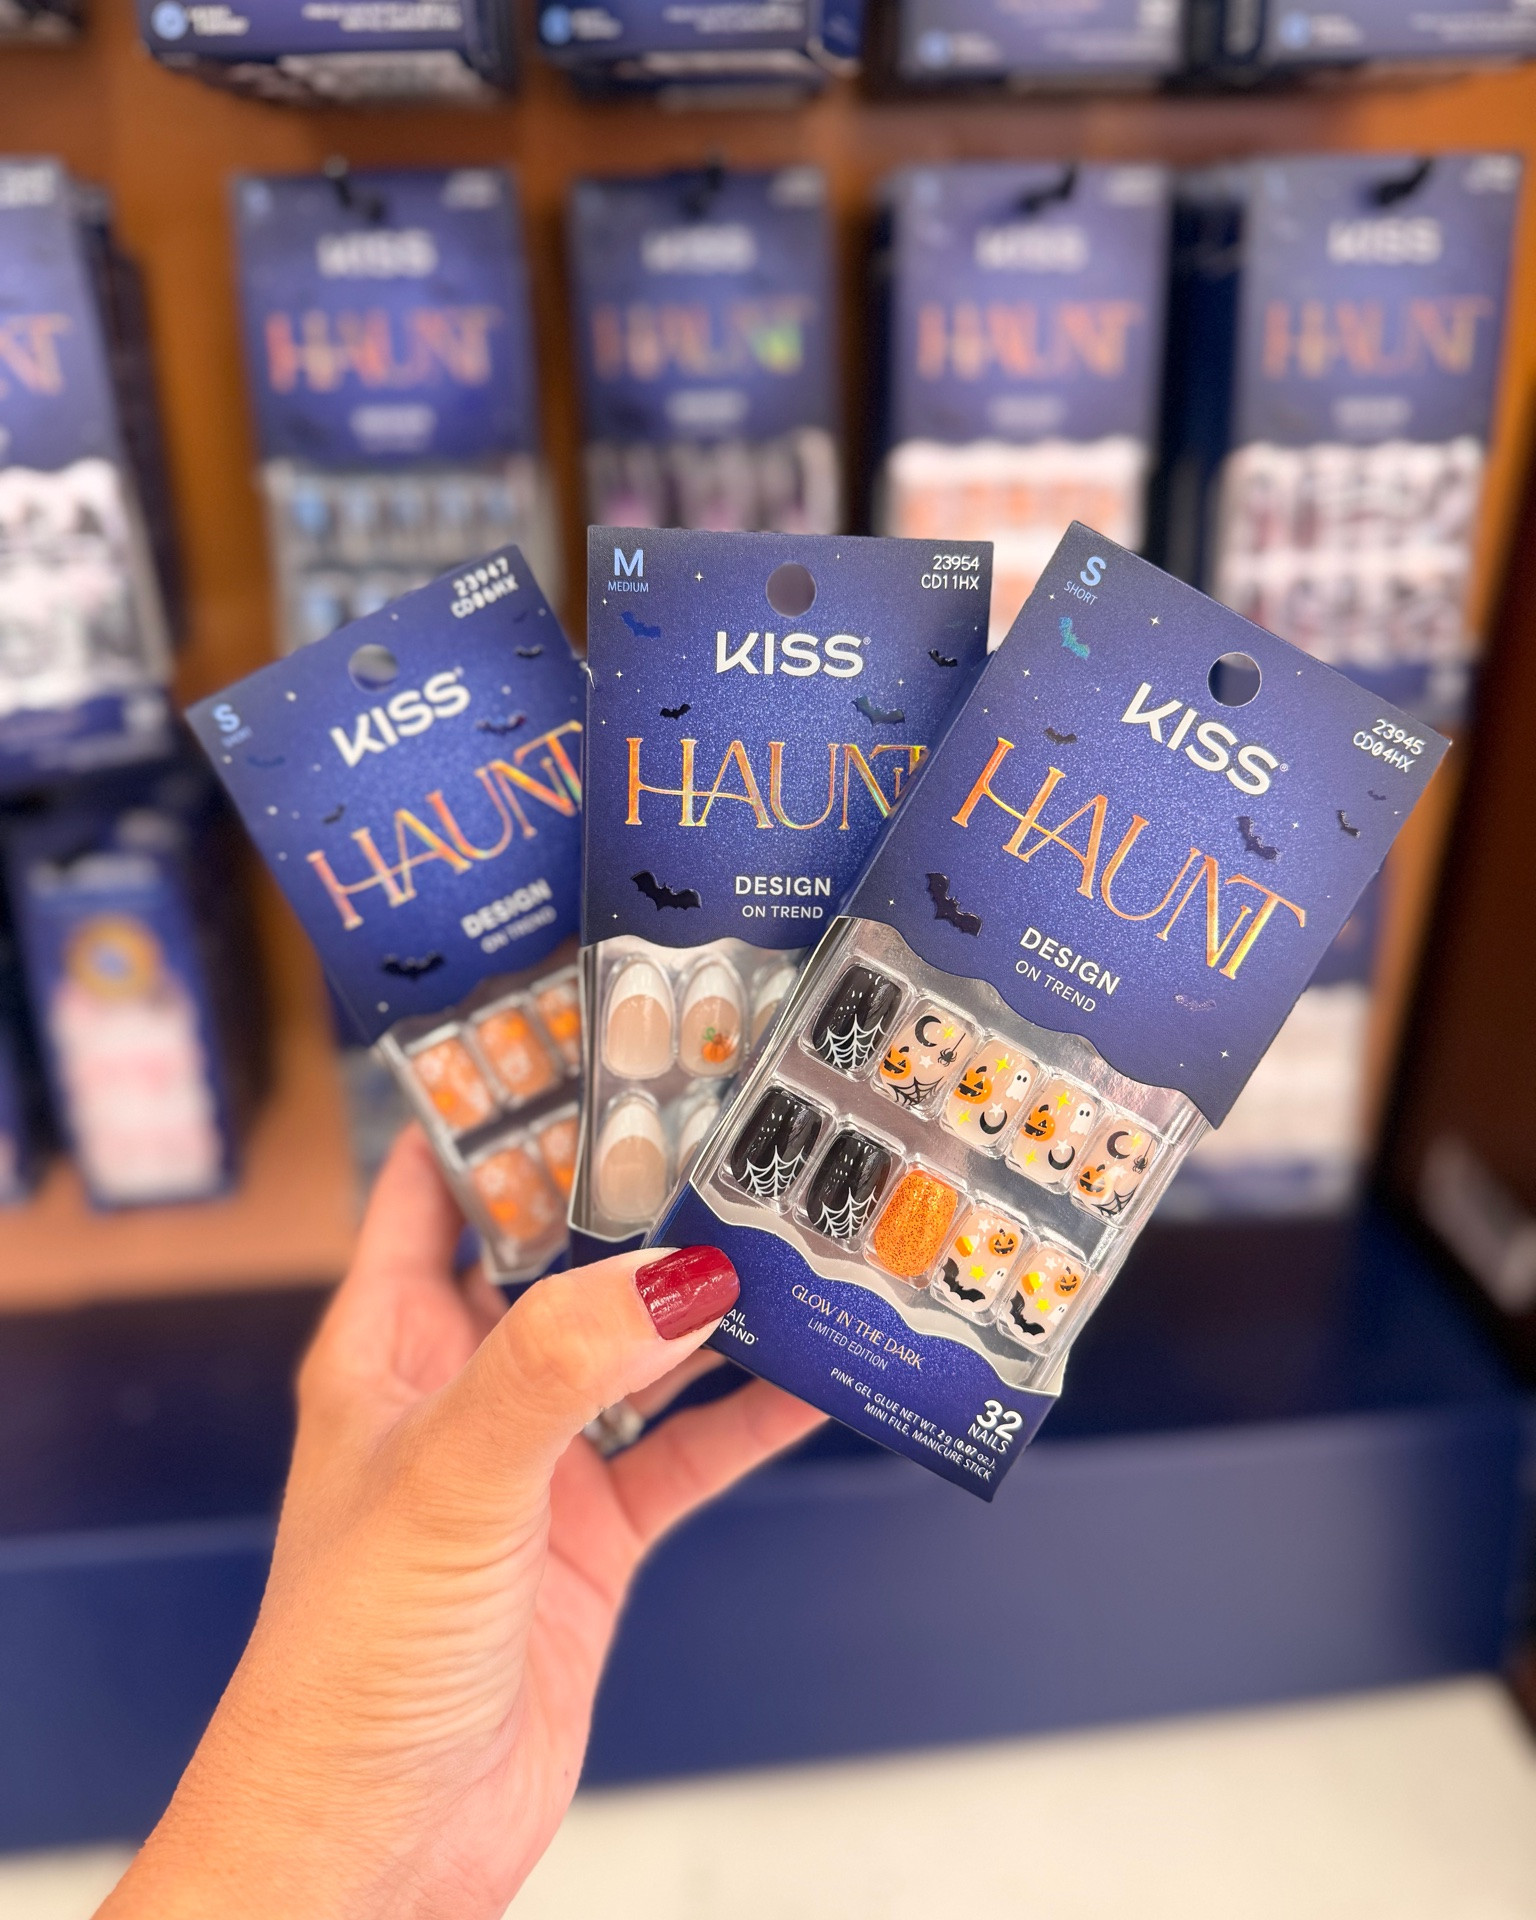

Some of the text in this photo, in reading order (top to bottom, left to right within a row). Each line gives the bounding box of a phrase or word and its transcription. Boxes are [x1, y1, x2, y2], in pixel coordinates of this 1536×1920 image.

[613, 547, 644, 577] M
[932, 555, 980, 571] 23954
[1080, 556, 1107, 587] S
[607, 580, 649, 593] MEDIUM
[921, 573, 980, 590] CD11HX
[1063, 580, 1098, 606] SHORT
[213, 703, 241, 732] S
[1353, 731, 1416, 773] CD04HX
[1371, 718, 1427, 756] 23945
[951, 737, 1306, 980] HAUNT
[735, 875, 831, 896] DESIGN
[461, 878, 553, 939] DESIGN
[742, 905, 824, 919] ON TREND
[1020, 926, 1121, 995] DESIGN
[1015, 960, 1096, 1012] ON TREND
[726, 1308, 746, 1327] AIL
[791, 1284, 926, 1370] GLOW IN THE DARK
[807, 1317, 889, 1371] LIMITED EDITION
[830, 1367, 854, 1388] PINK
[854, 1381, 873, 1399] GEL
[874, 1393, 900, 1413] GLUE
[899, 1407, 920, 1425] NET
[919, 1418, 937, 1435] WT.
[953, 1438, 978, 1456] (0.07
[976, 1399, 1023, 1442] 32
[863, 1402, 992, 1481] MINI FILE, MANICURE STICK
[967, 1422, 1010, 1454] NAILS
